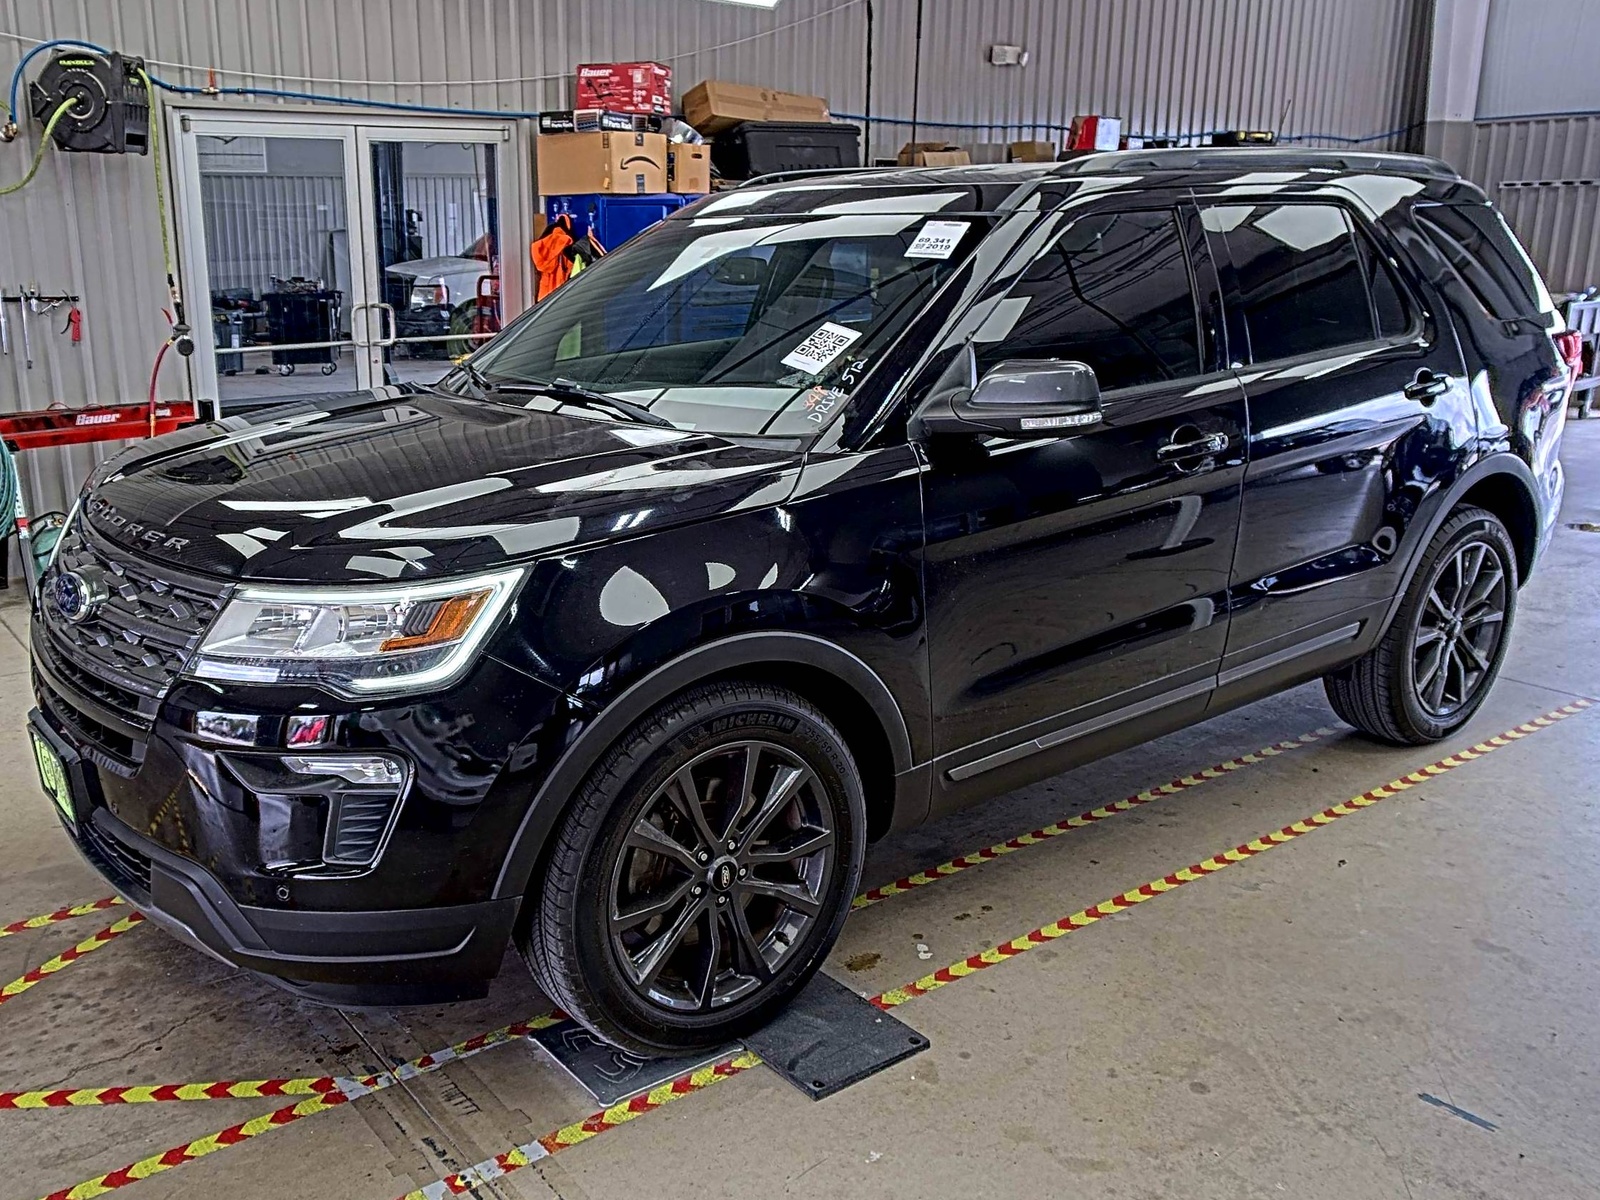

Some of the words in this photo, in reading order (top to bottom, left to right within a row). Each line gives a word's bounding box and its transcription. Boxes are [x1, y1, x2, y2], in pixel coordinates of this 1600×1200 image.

[580, 68, 613, 77] Bauer
[807, 386, 844, 423] DRIVE
[75, 413, 120, 426] Bauer
[712, 713, 795, 734] MICHELIN
[804, 726, 833, 754] 255/50
[830, 752, 839, 763] R
[835, 761, 847, 776] 20
